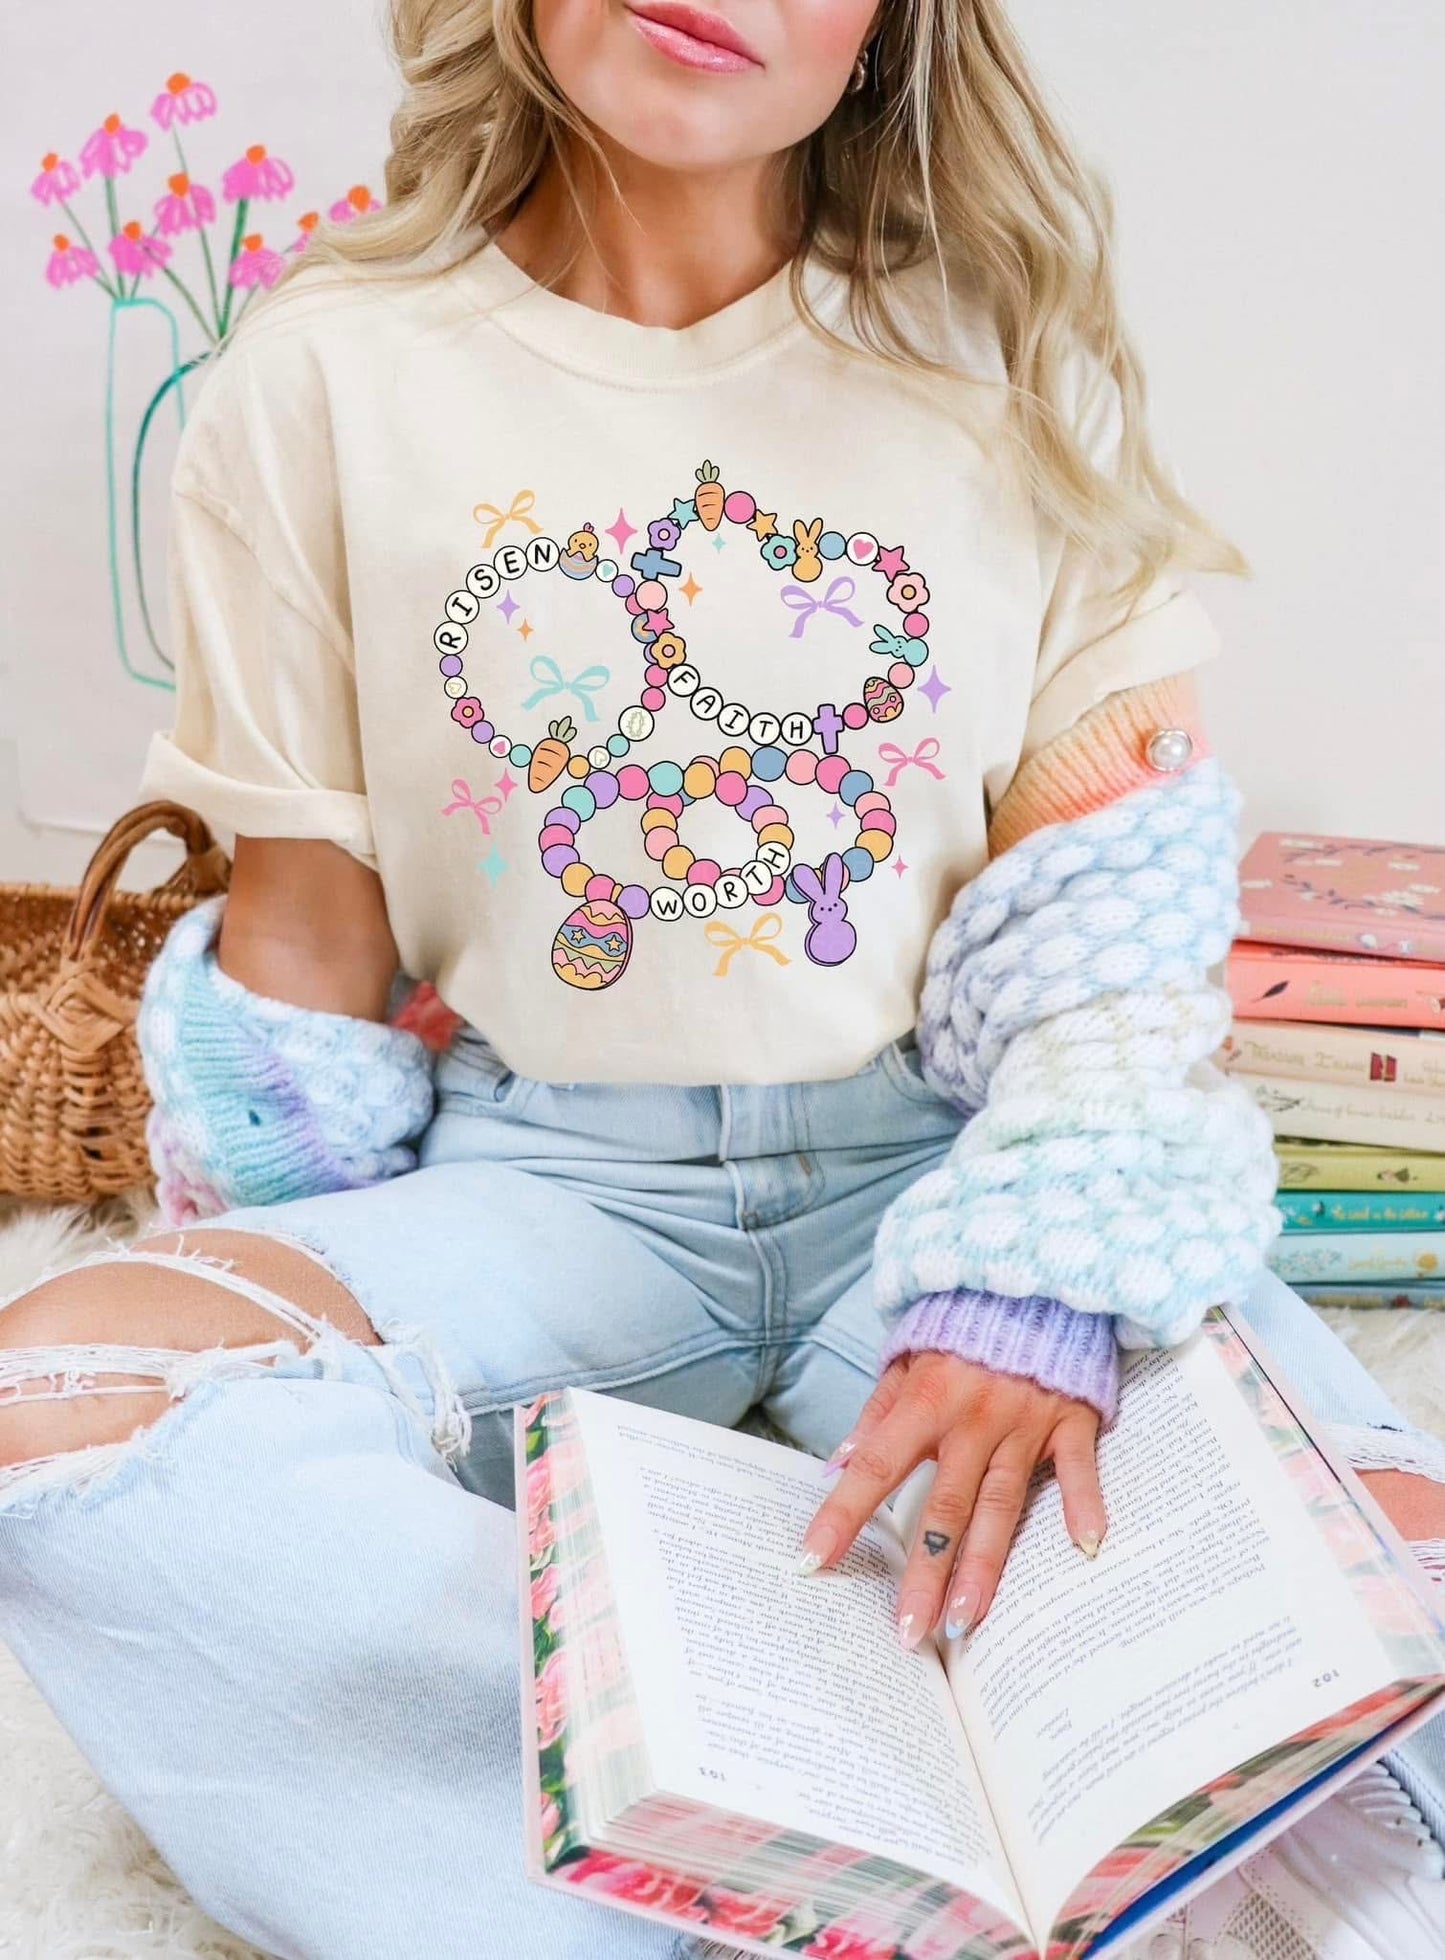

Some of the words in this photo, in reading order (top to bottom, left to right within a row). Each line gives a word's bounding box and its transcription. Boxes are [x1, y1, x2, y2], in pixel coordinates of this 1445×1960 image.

[439, 543, 551, 649] RISEN
[673, 670, 803, 739] FAITH
[656, 848, 785, 915] WORTH
[1313, 1669, 1340, 1688] 102
